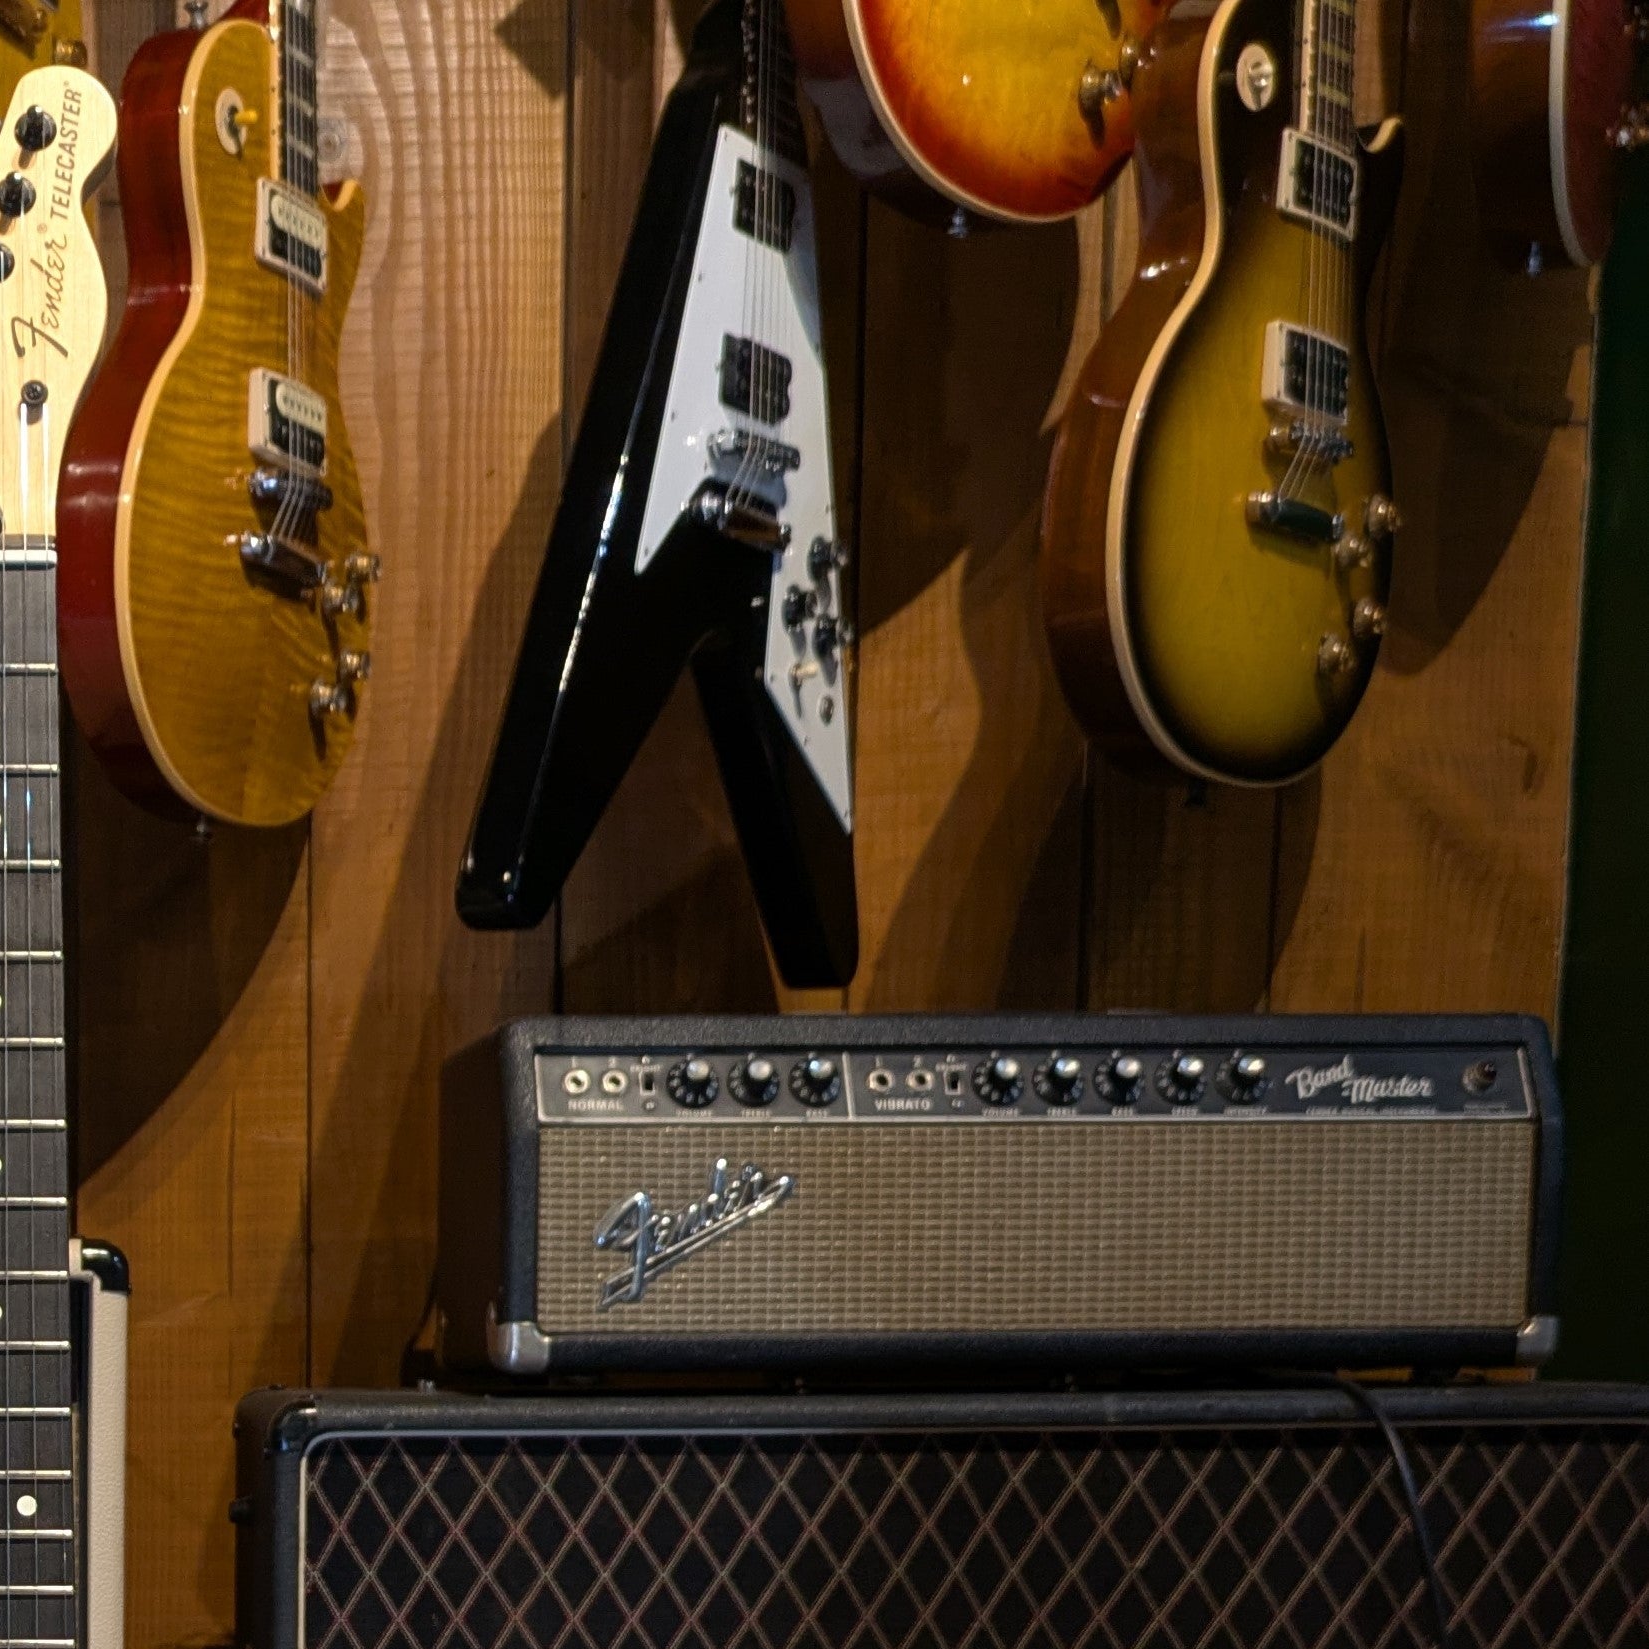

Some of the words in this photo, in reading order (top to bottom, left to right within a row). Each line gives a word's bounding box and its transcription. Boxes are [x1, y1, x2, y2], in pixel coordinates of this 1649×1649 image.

[1284, 1053, 1354, 1099] Band
[1341, 1073, 1434, 1104] Master
[567, 1099, 624, 1111] NORMAL
[874, 1098, 931, 1111] VIBRATO
[593, 1157, 794, 1311] Fender
